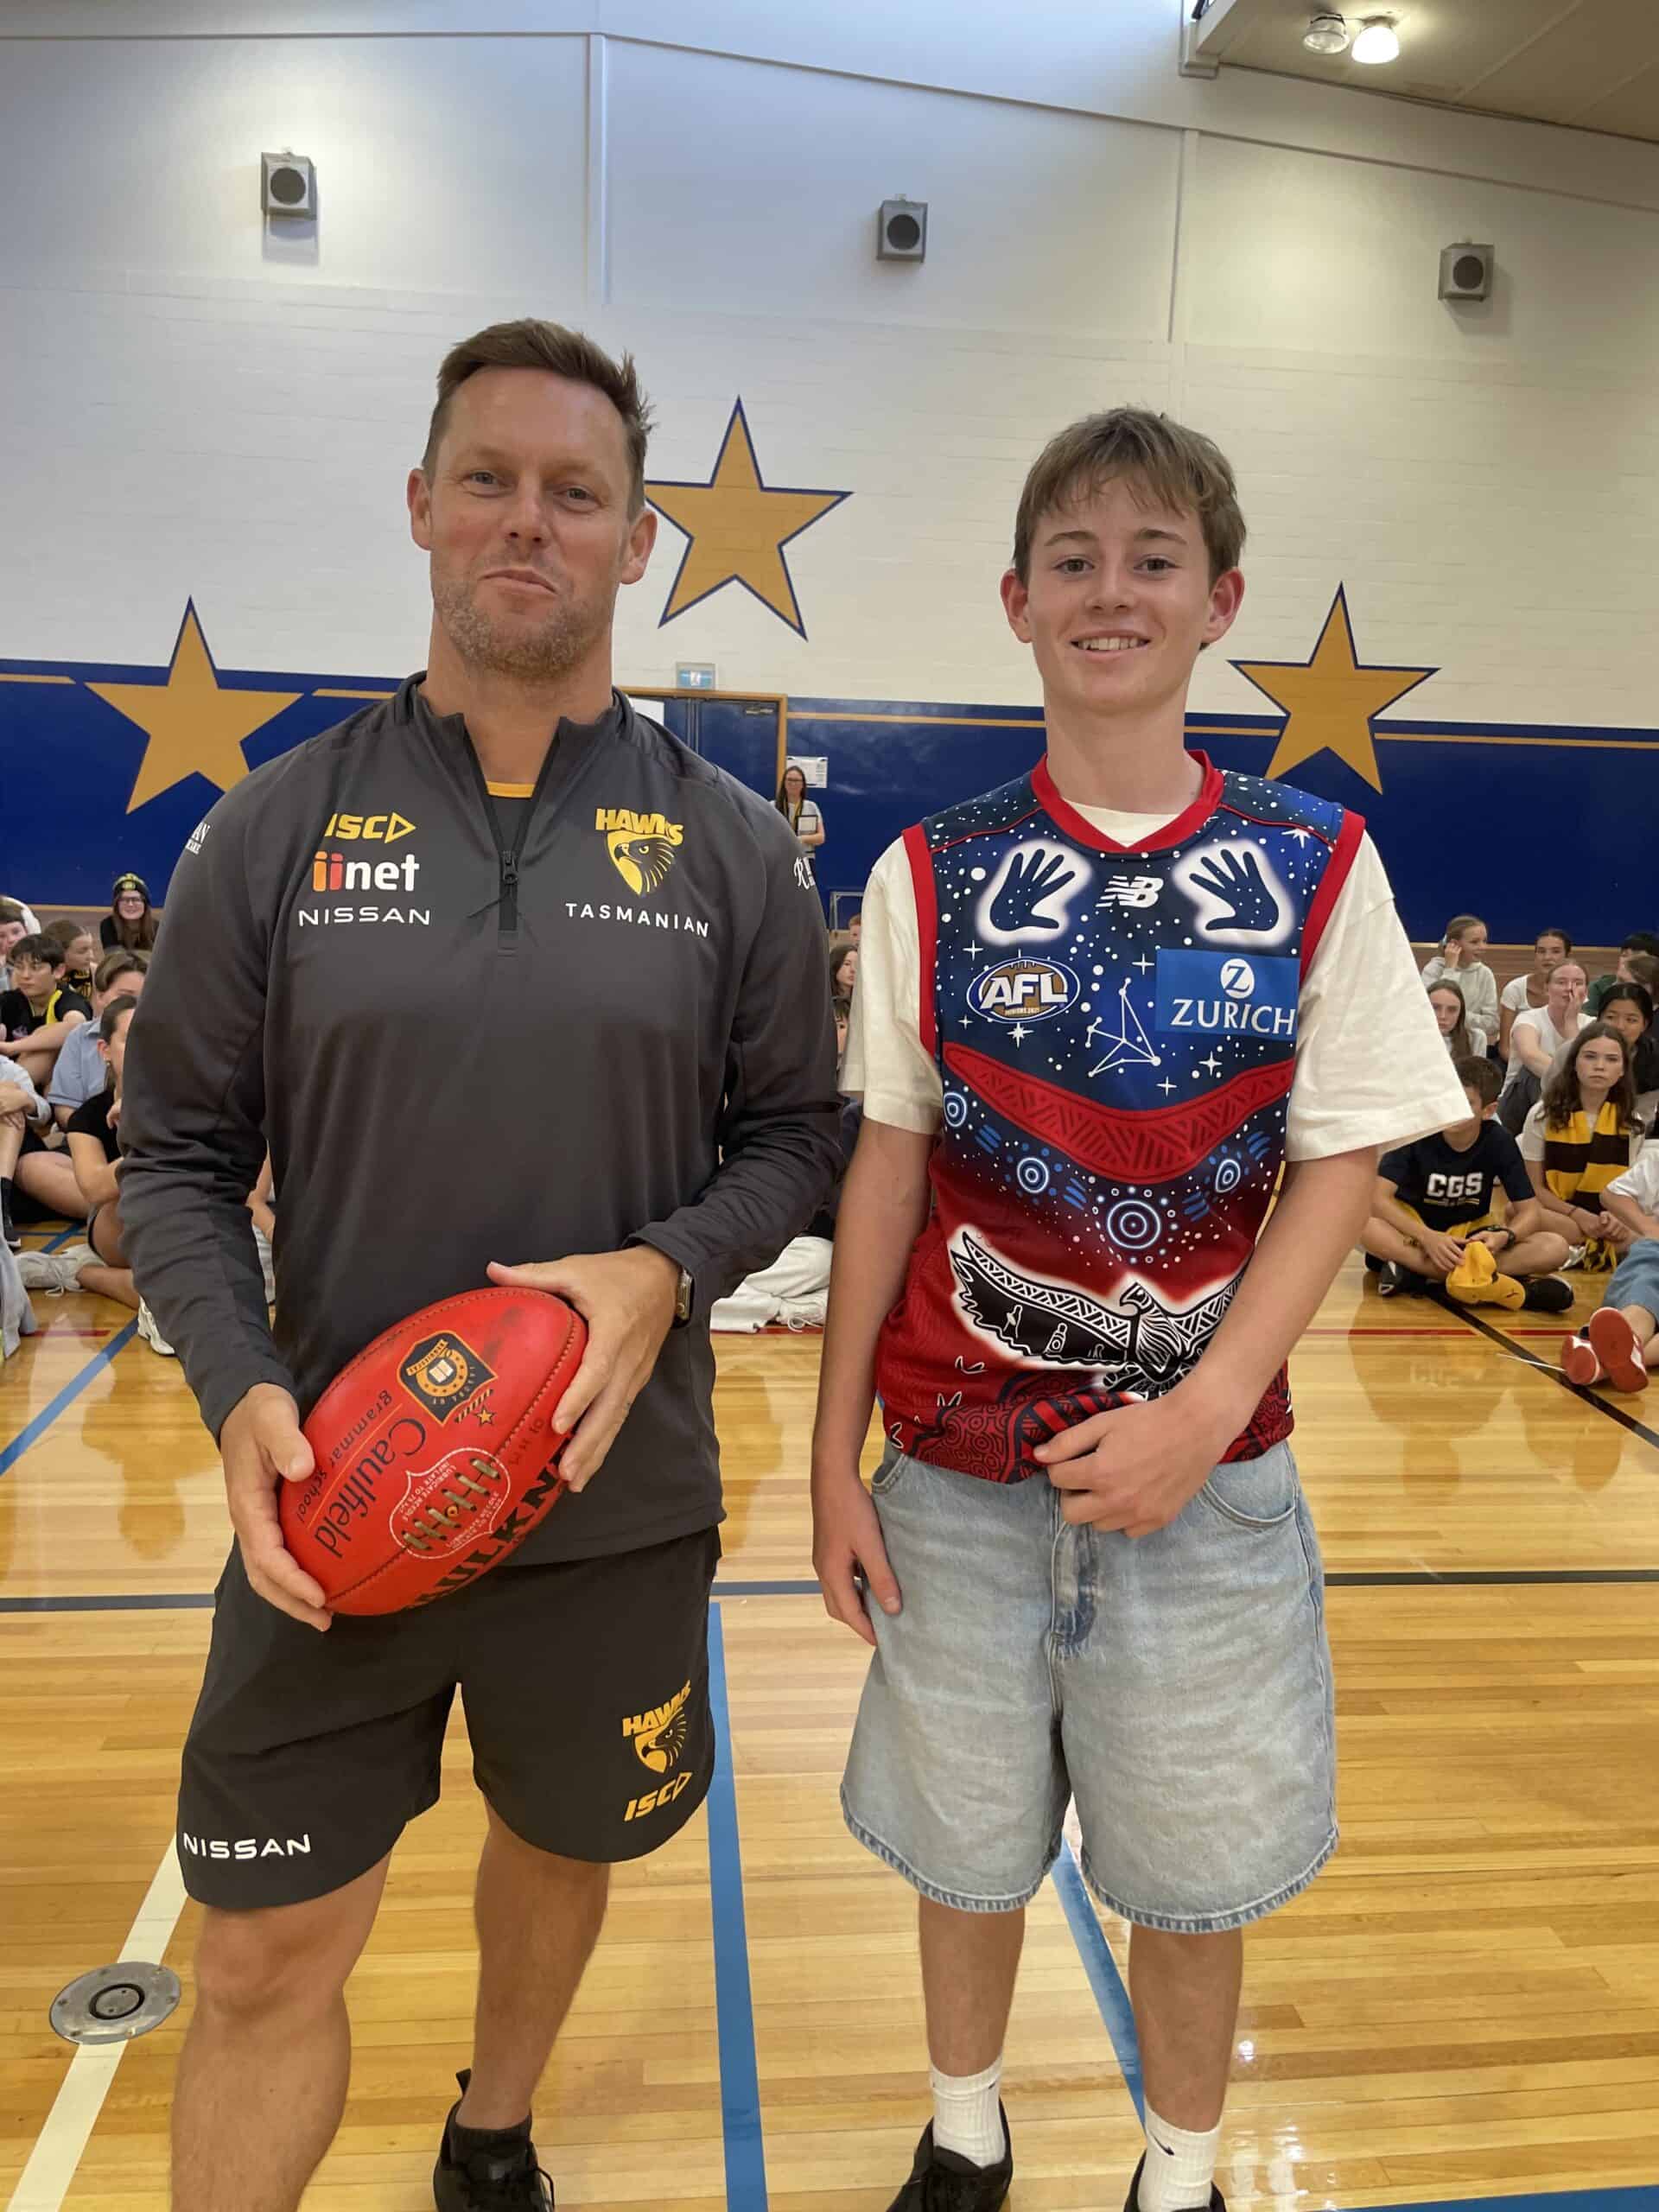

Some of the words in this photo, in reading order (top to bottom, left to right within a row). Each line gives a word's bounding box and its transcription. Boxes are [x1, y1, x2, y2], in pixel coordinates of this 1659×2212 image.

[595, 808, 684, 847] HAWKS
[313, 851, 420, 892] iinet
[299, 907, 430, 927] NISSAN
[565, 903, 709, 938] TASMANIAN
[980, 972, 1069, 1010] AFL
[1171, 999, 1296, 1035] ZURICH
[1427, 1172, 1484, 1198] CGS
[329, 1389, 393, 1469] grammar
[296, 1469, 328, 1522] school
[314, 1418, 426, 1559] Caulfield
[183, 1832, 313, 1860] NISSAN
